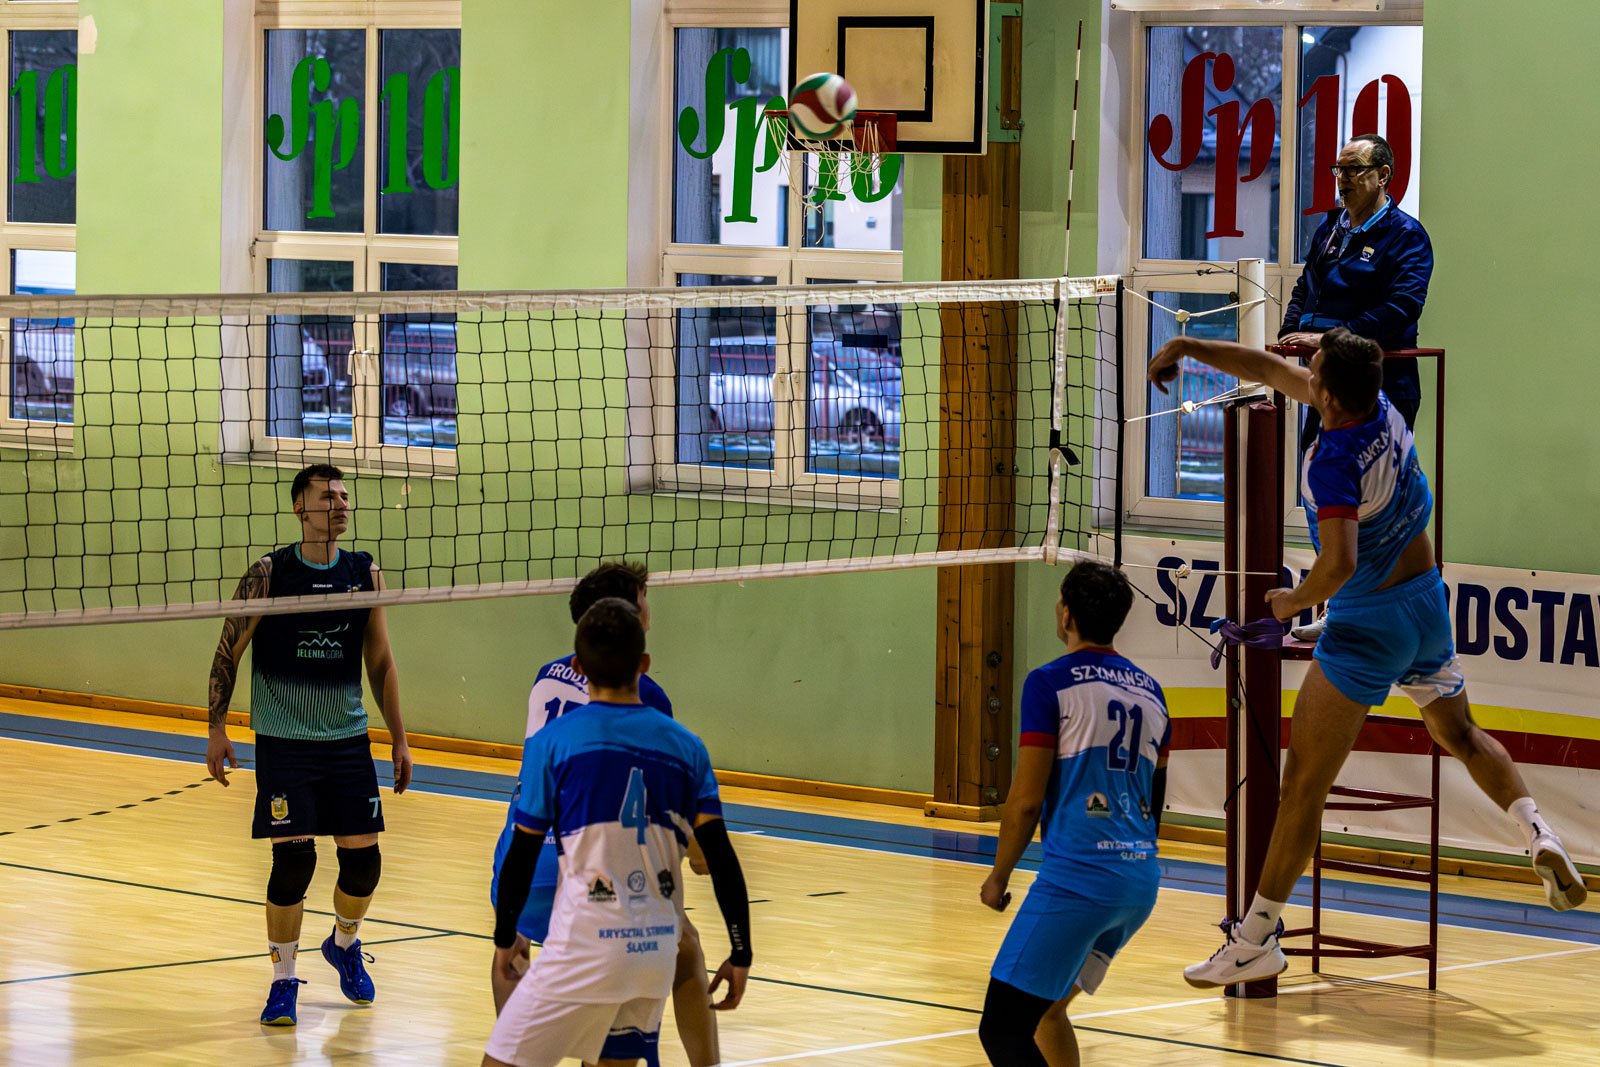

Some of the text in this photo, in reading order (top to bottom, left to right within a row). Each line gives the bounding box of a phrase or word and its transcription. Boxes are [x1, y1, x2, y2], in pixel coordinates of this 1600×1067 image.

[10, 64, 77, 184] 10
[379, 66, 460, 195] 10
[1297, 74, 1412, 216] 10
[297, 648, 325, 659] JELENIA
[1070, 665, 1155, 691] SZYMAŃSKI
[1106, 699, 1143, 774] 21
[618, 766, 650, 845] 4
